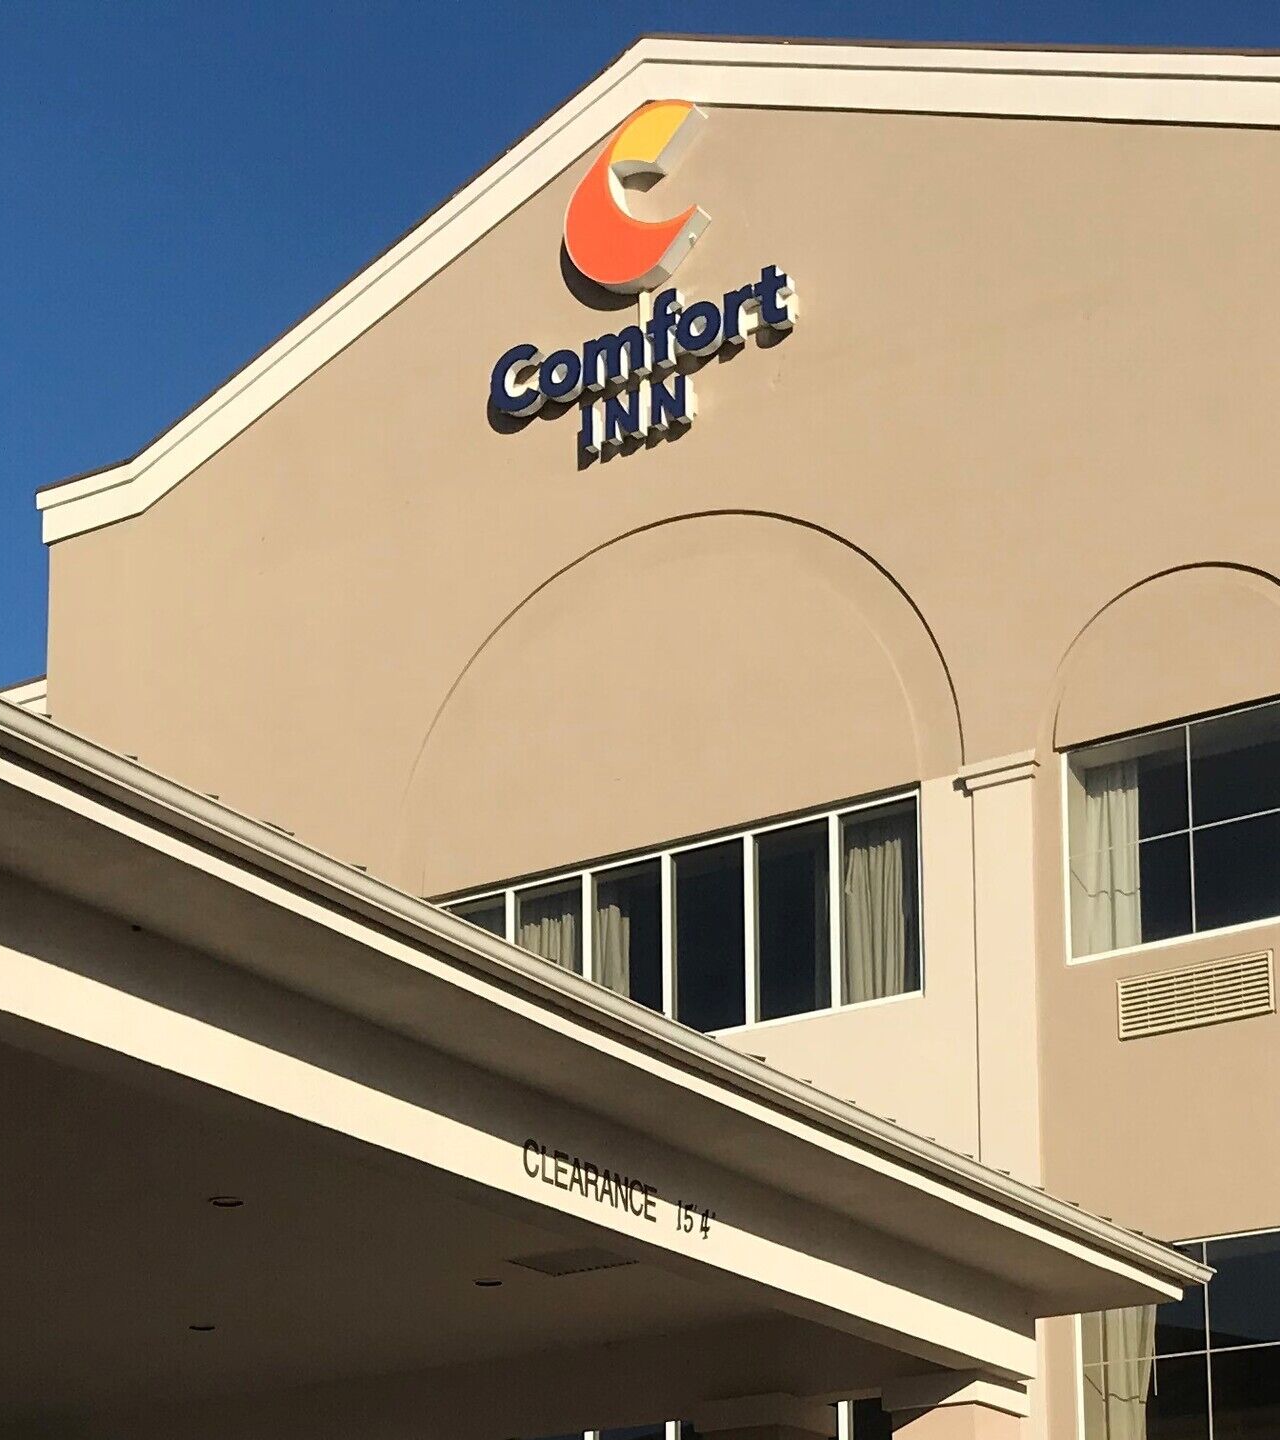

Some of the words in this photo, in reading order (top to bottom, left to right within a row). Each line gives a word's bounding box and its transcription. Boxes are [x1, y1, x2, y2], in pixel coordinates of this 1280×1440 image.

[489, 264, 792, 413] Comfort
[578, 374, 690, 453] INN
[522, 1138, 658, 1223] CLEARANCE
